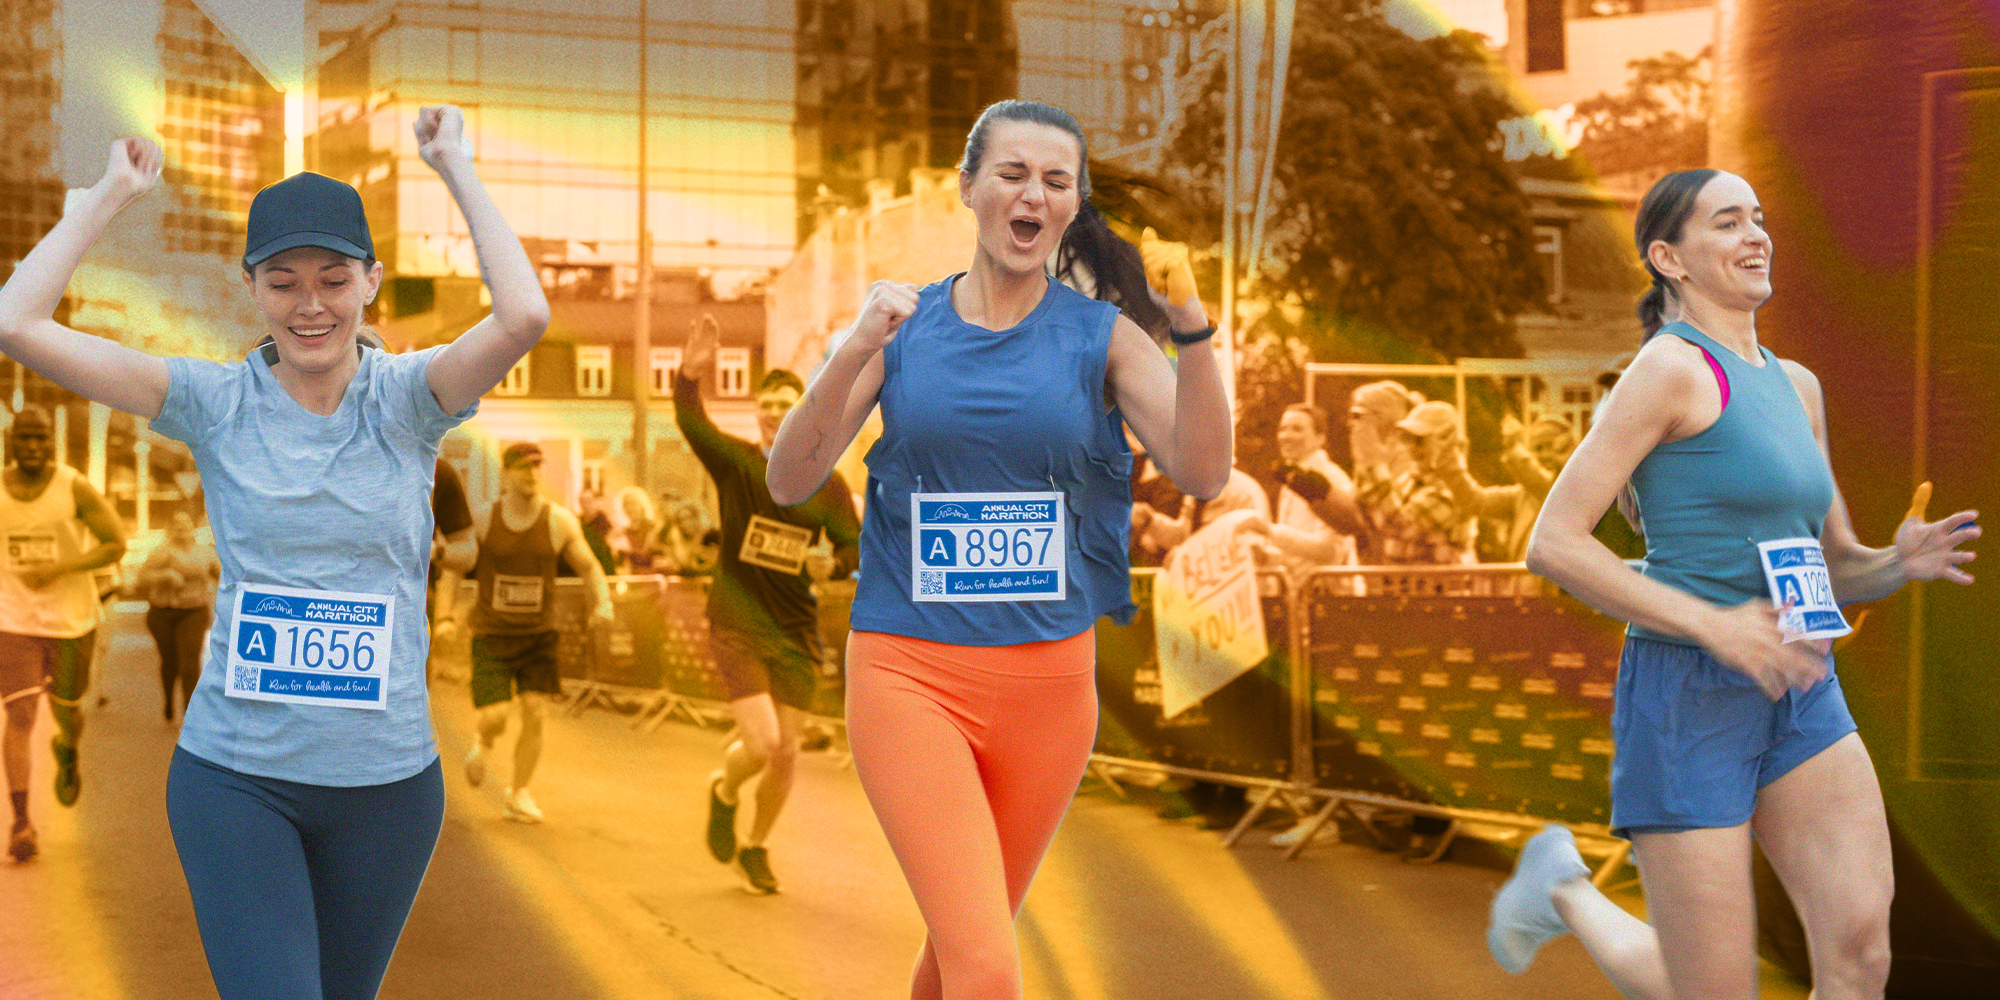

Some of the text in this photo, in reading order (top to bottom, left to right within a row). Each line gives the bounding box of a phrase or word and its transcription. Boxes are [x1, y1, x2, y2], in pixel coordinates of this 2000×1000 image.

[981, 504, 1023, 512] ANNUAL
[981, 511, 1049, 521] MARATHON
[929, 537, 949, 560] A
[965, 528, 1054, 567] 8967
[954, 574, 1050, 591] Run for health and fun!
[306, 602, 379, 614] ANNUAL CITY
[305, 610, 377, 623] MARATHON
[246, 630, 266, 656] A
[287, 626, 375, 672] 1656
[269, 679, 371, 693] Run for health and fun!
